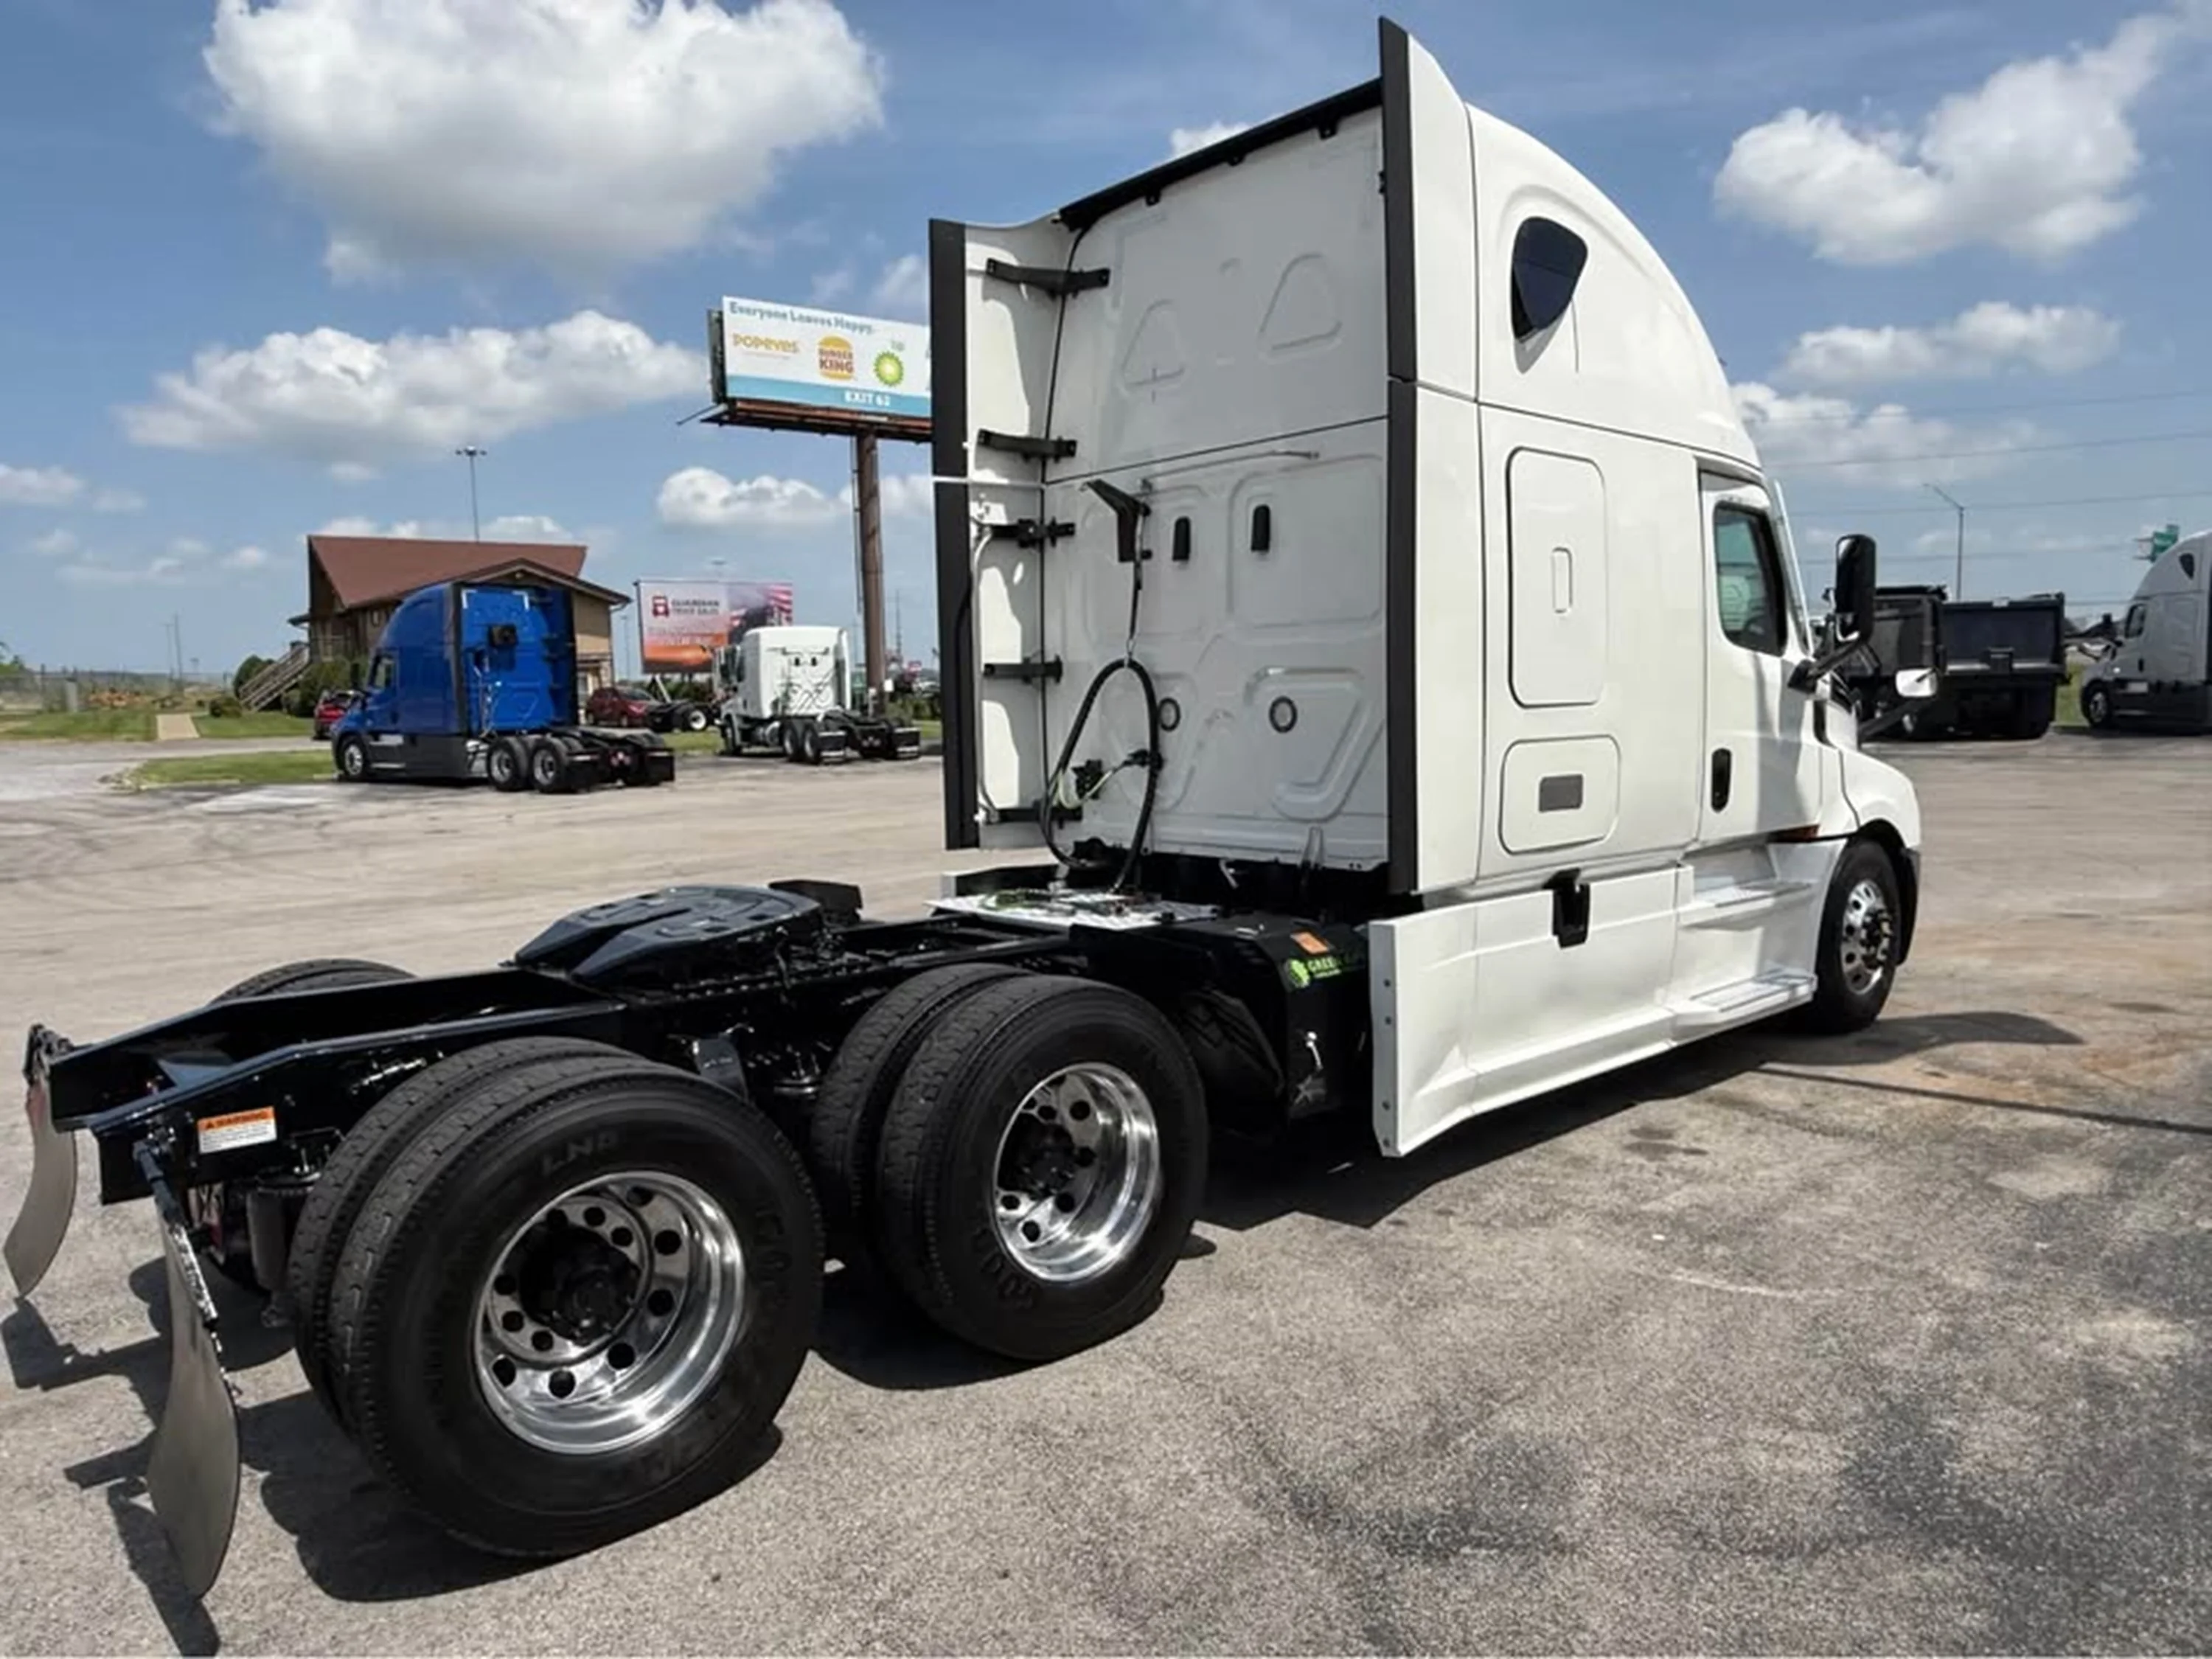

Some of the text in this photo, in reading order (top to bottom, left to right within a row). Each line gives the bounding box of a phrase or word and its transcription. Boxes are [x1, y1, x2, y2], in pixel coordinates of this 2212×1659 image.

[729, 302, 787, 320] Everyone
[790, 309, 832, 327] Leaves
[732, 333, 799, 354] POPEYES
[818, 348, 852, 361] BURGER
[818, 358, 853, 374] KING
[844, 391, 873, 405] EXIT
